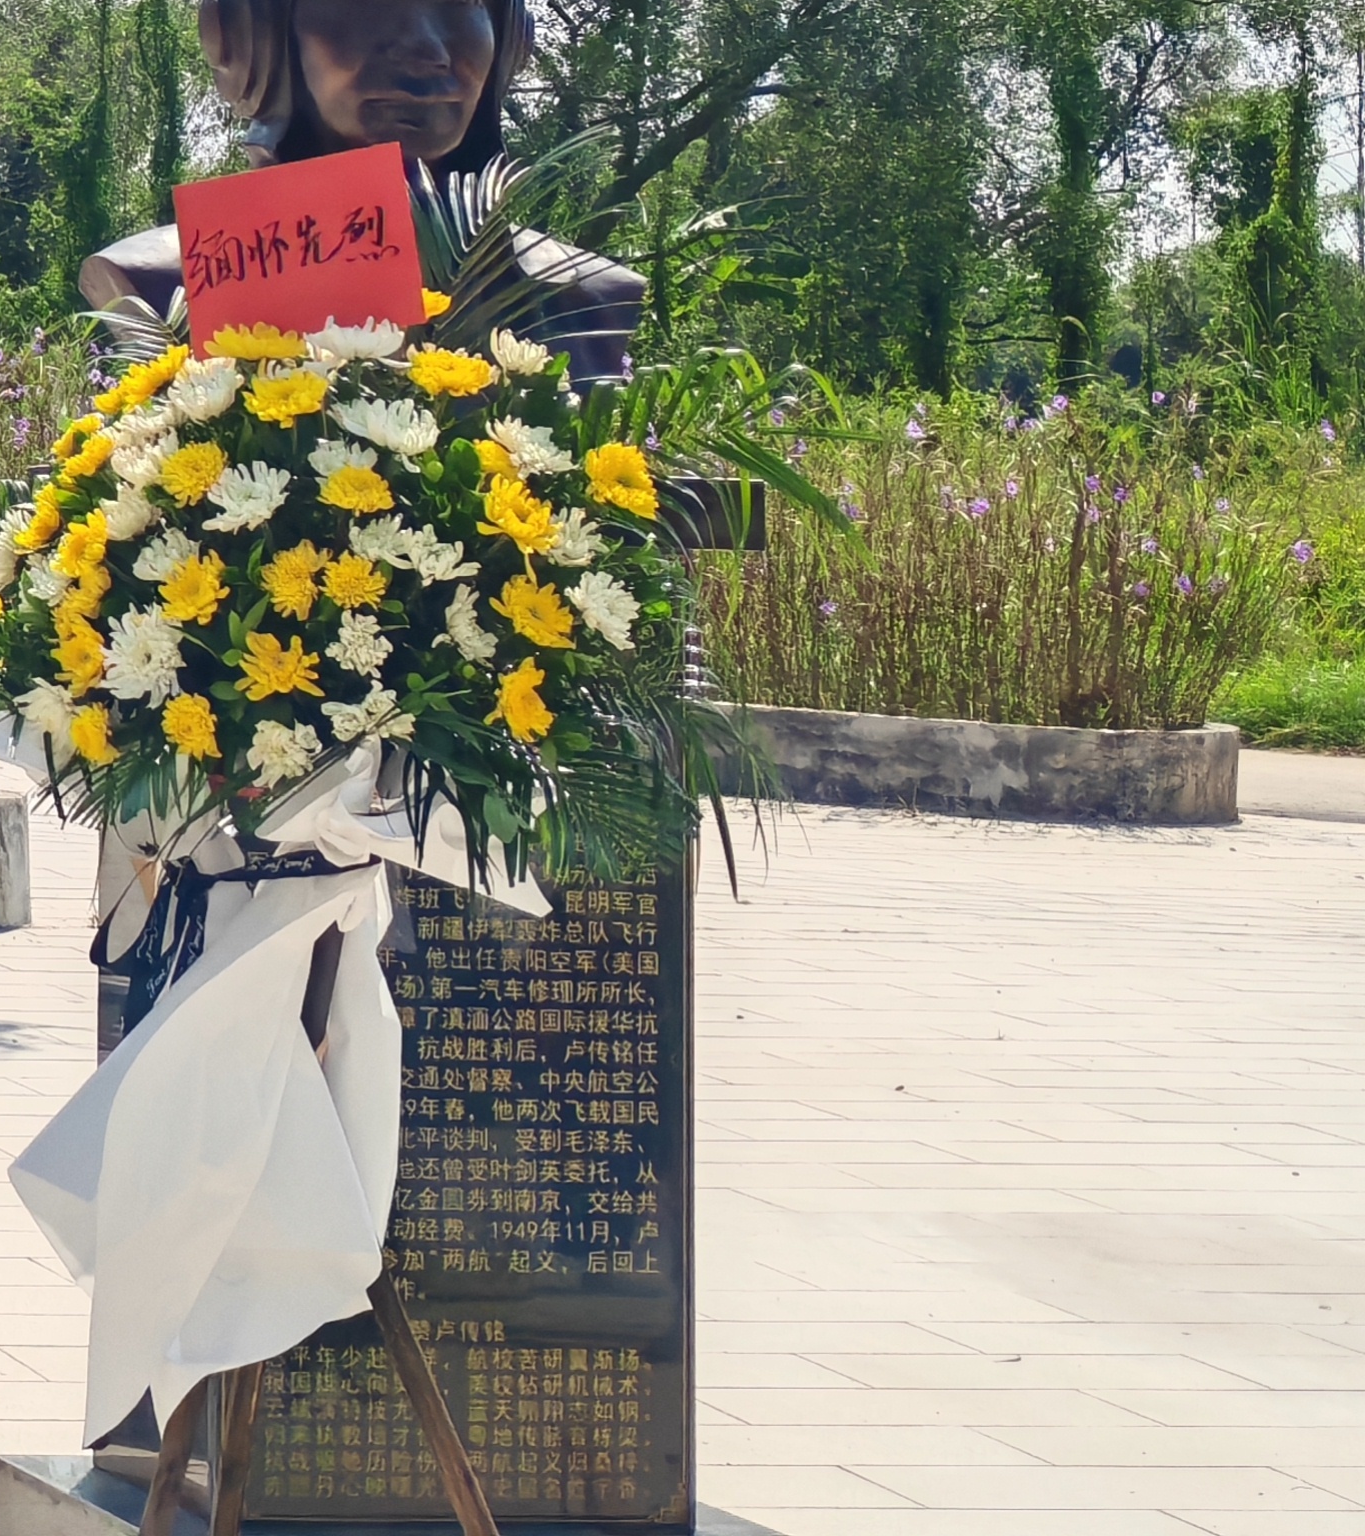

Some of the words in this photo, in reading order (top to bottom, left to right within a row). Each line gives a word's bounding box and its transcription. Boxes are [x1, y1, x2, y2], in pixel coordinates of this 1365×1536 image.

[185, 204, 400, 300] 缅怀先烈
[417, 916, 658, 945] 新疆伊犁轰炸总队飞行
[417, 1038, 658, 1065] 抗战胜利后，卢传铭任
[400, 1098, 660, 1126] 9年春，他两次飞载国民
[385, 1218, 660, 1245] 动经费。1949年11月，卢
